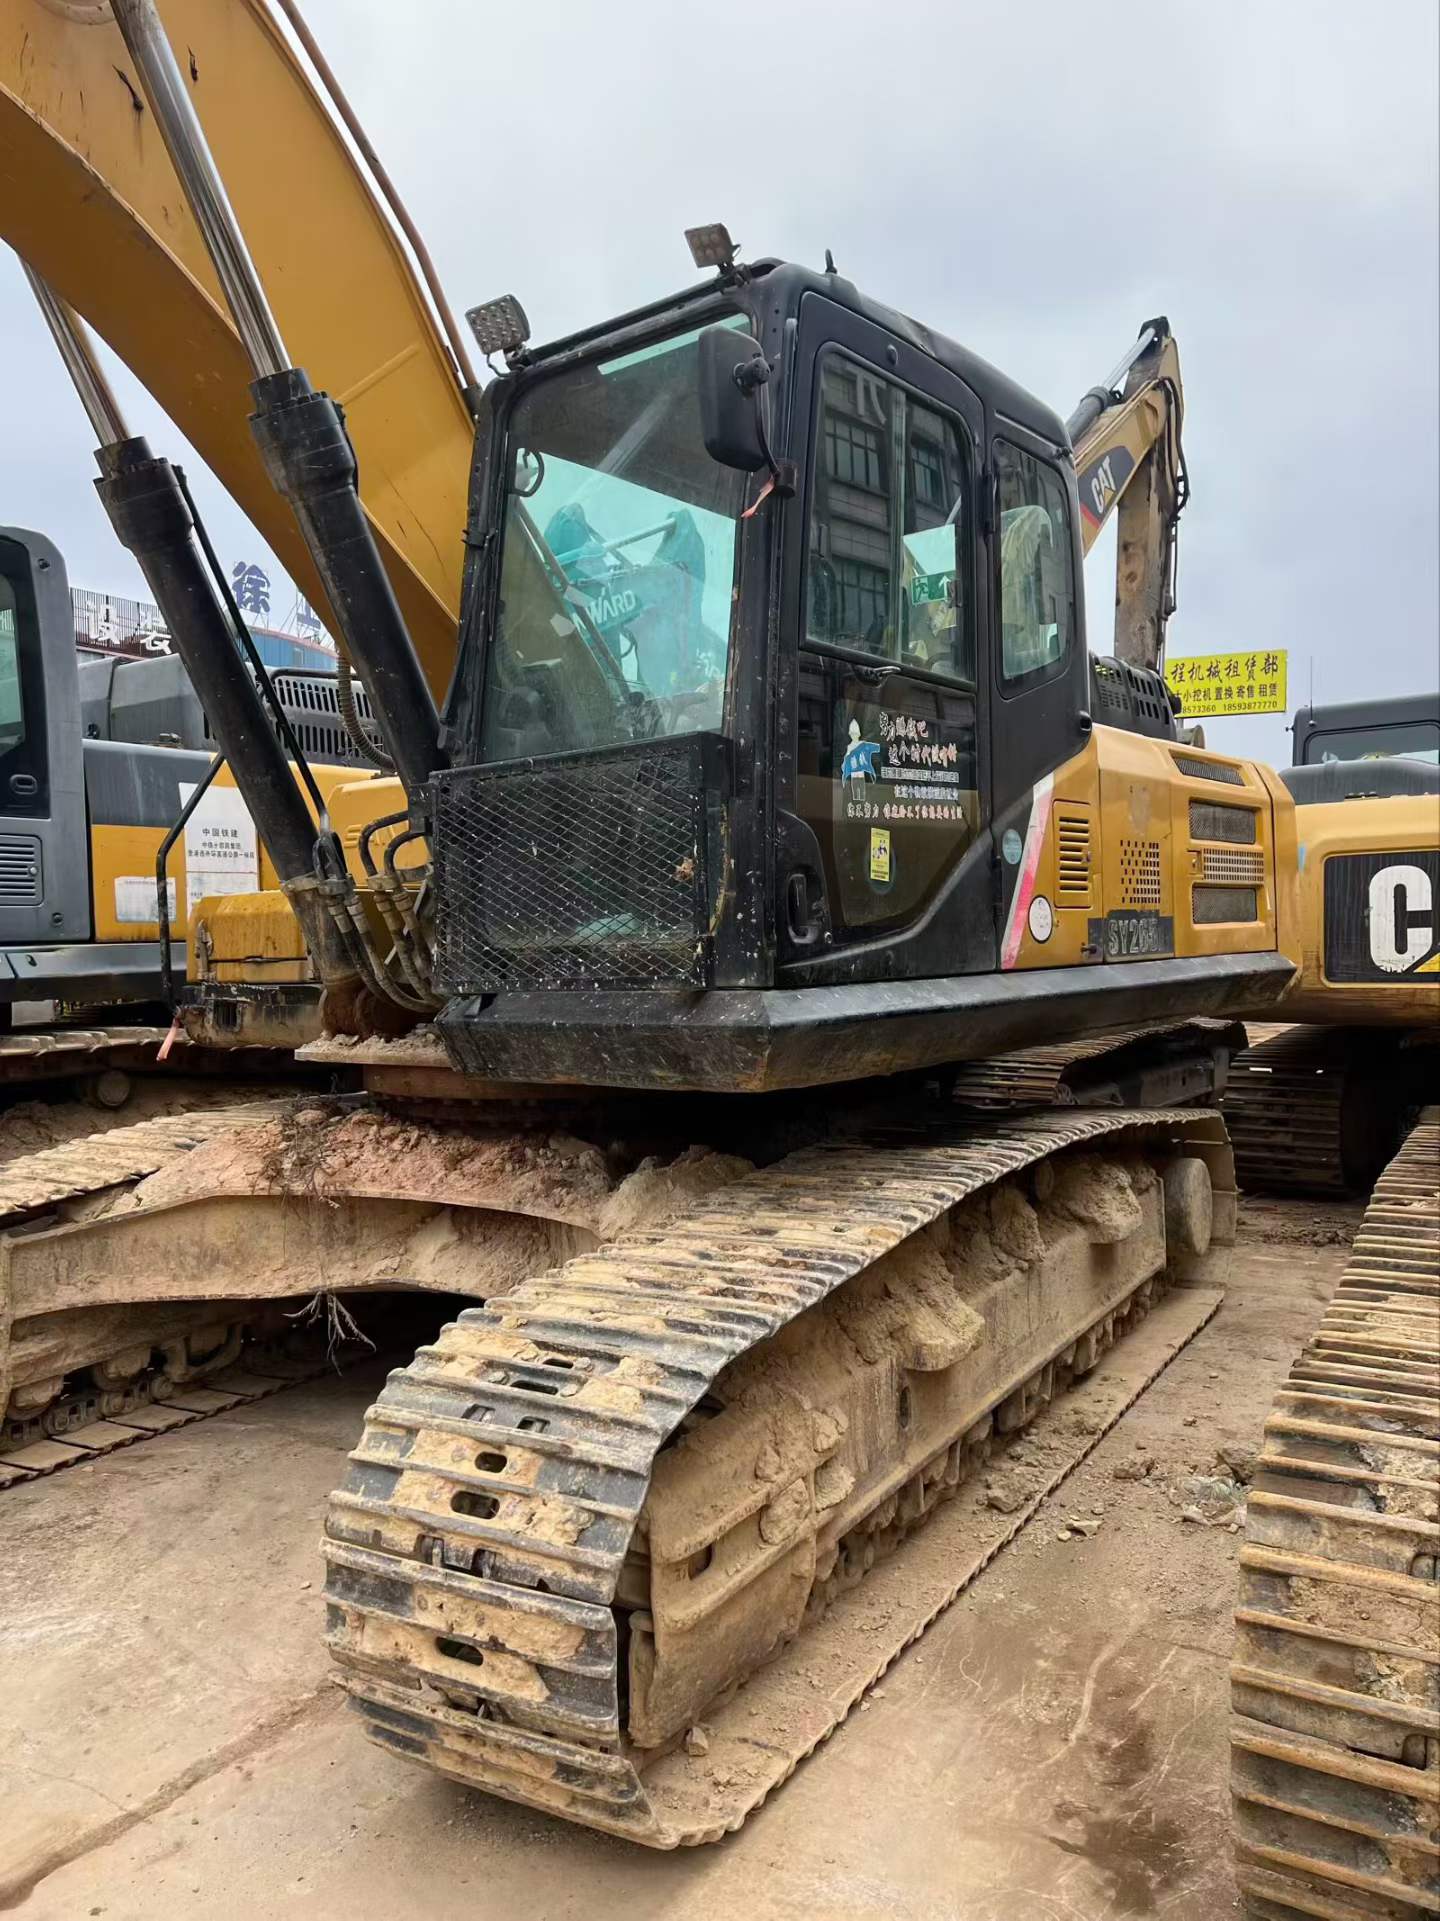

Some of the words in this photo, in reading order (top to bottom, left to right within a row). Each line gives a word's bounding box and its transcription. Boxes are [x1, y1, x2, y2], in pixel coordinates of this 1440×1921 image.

[1091, 455, 1116, 514] CAT
[1165, 653, 1279, 684] 程机械租赁部
[202, 828, 239, 838] 中国铁建
